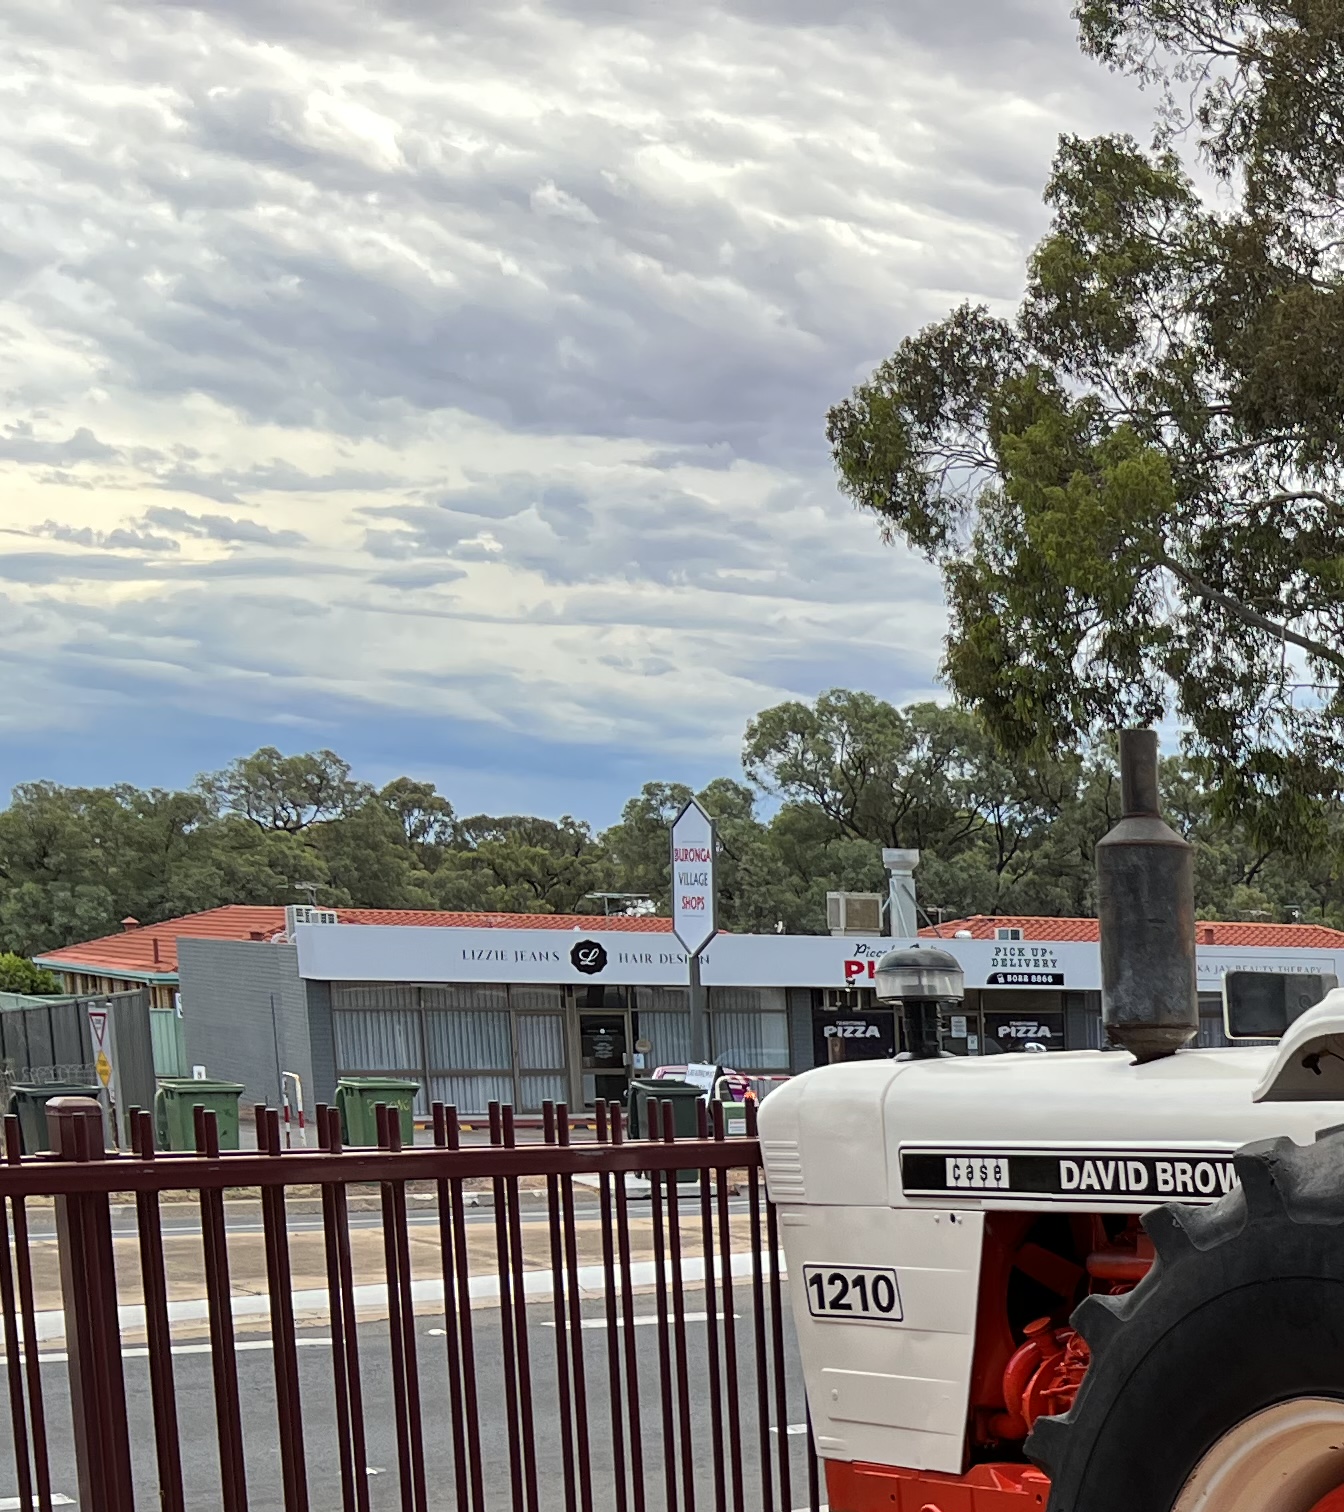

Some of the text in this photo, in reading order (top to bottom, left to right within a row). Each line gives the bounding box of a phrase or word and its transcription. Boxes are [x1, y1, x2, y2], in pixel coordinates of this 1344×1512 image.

[674, 847, 712, 863] BURONGA
[678, 871, 708, 886] VILLAGE
[682, 895, 705, 910] SHOPS
[462, 949, 508, 962] LIZZIE
[514, 950, 561, 963] JEANS
[994, 946, 1026, 957] PICK
[618, 952, 711, 965] HAIR DESIN
[991, 958, 1058, 969] DELIVERY
[1214, 964, 1231, 975] JAY
[1235, 965, 1275, 973] BEAUTY
[1278, 965, 1322, 974] THERAPY
[823, 1025, 881, 1038] PIZZA
[997, 1025, 1052, 1038] PIZZA
[1059, 1159, 1149, 1191] DAVID
[808, 1271, 896, 1313] 1210
